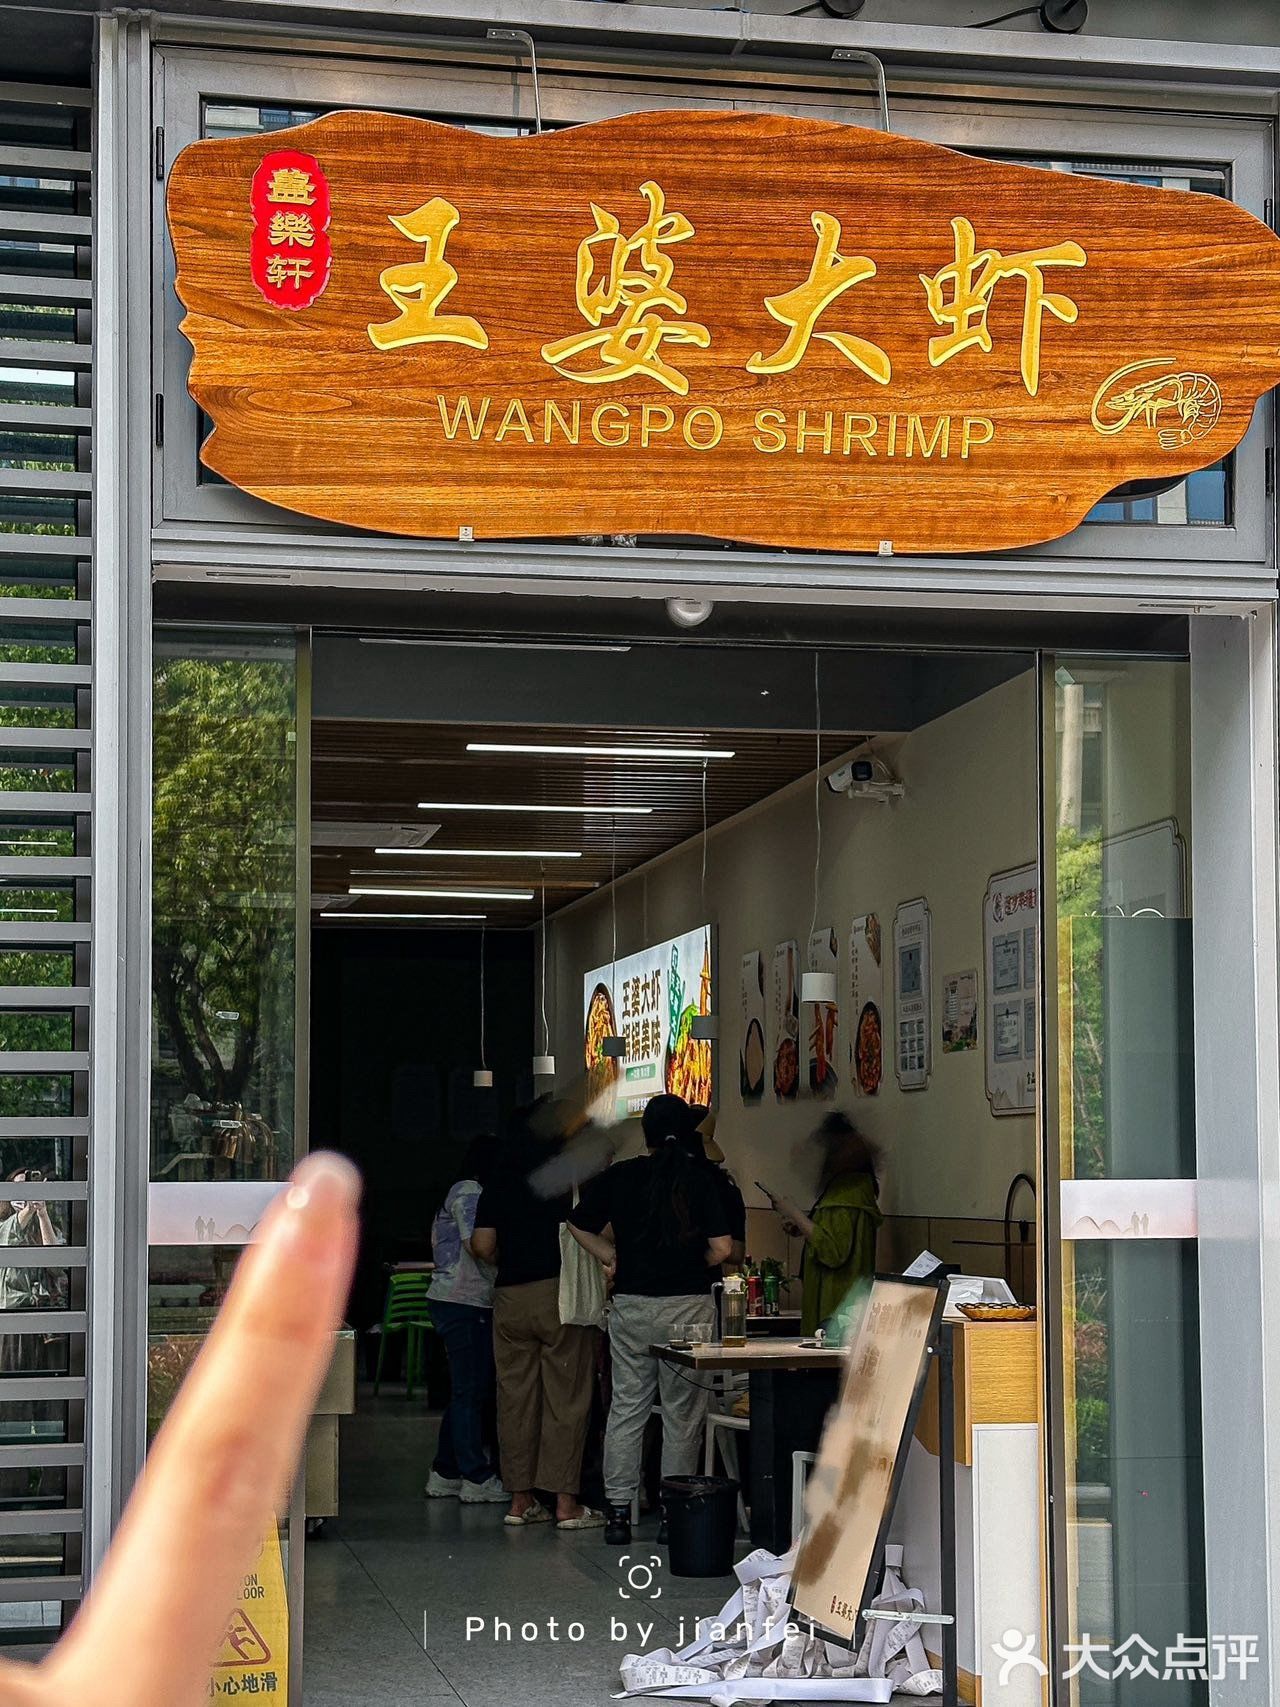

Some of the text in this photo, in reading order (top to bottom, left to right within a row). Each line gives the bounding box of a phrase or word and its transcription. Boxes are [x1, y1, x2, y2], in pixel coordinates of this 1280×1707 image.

[367, 180, 1087, 396] 王婆大虾
[437, 394, 996, 459] WANGPO SHRIMP
[622, 969, 661, 1020] 王婆大虾
